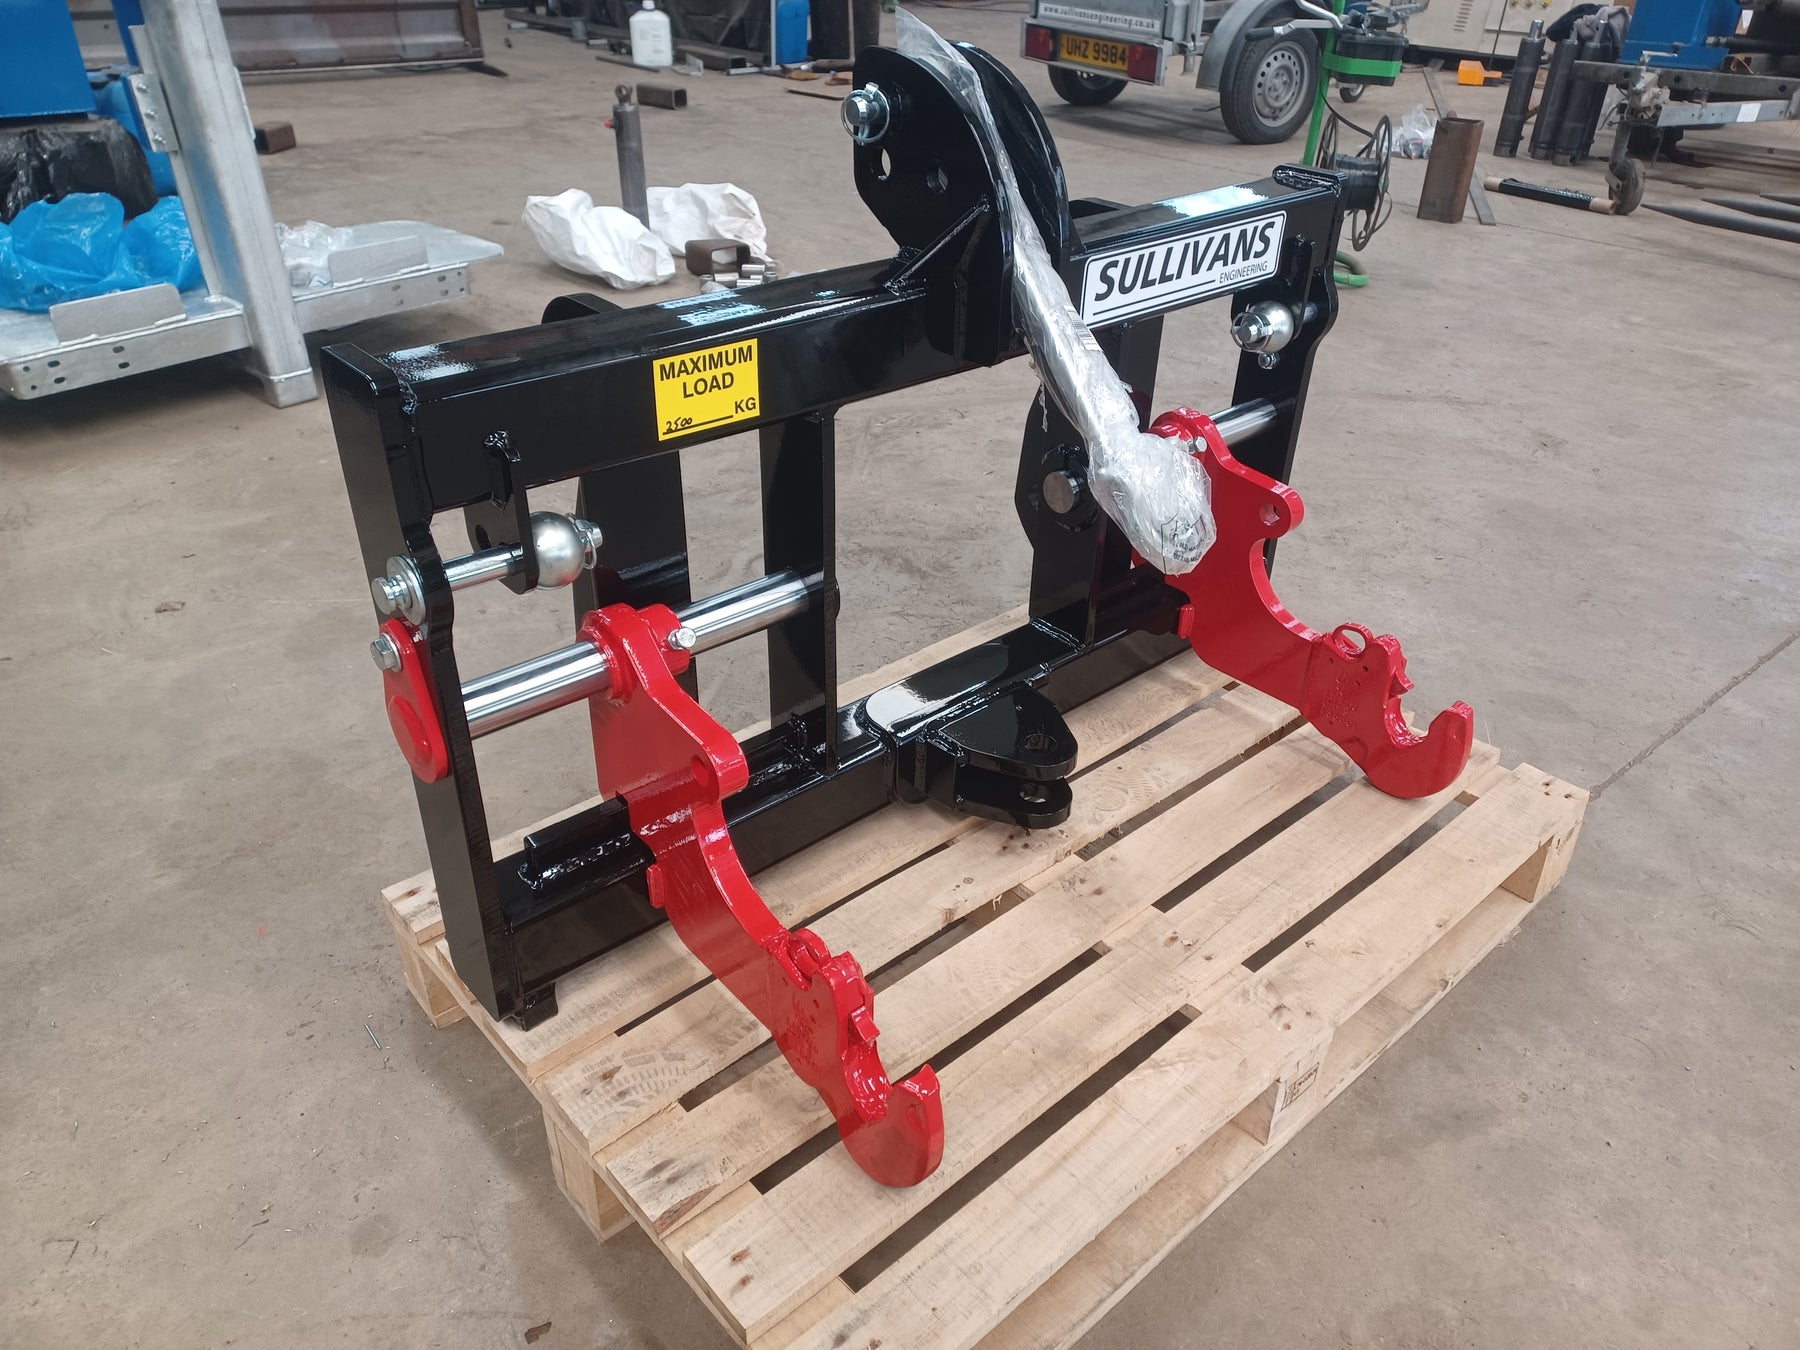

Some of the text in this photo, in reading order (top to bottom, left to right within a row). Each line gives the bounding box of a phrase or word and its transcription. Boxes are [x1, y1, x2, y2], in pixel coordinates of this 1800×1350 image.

[1043, 6, 1156, 30] www.sullivansengineering.co.uk
[1066, 36, 1127, 66] UHZ 9984
[1094, 221, 1276, 302] SULLIVANS
[1219, 260, 1268, 284] ENGINEERING
[659, 344, 753, 382] MAXIMUM
[682, 371, 735, 399] LOAD
[734, 396, 756, 414] KG
[665, 416, 693, 433] 2500
